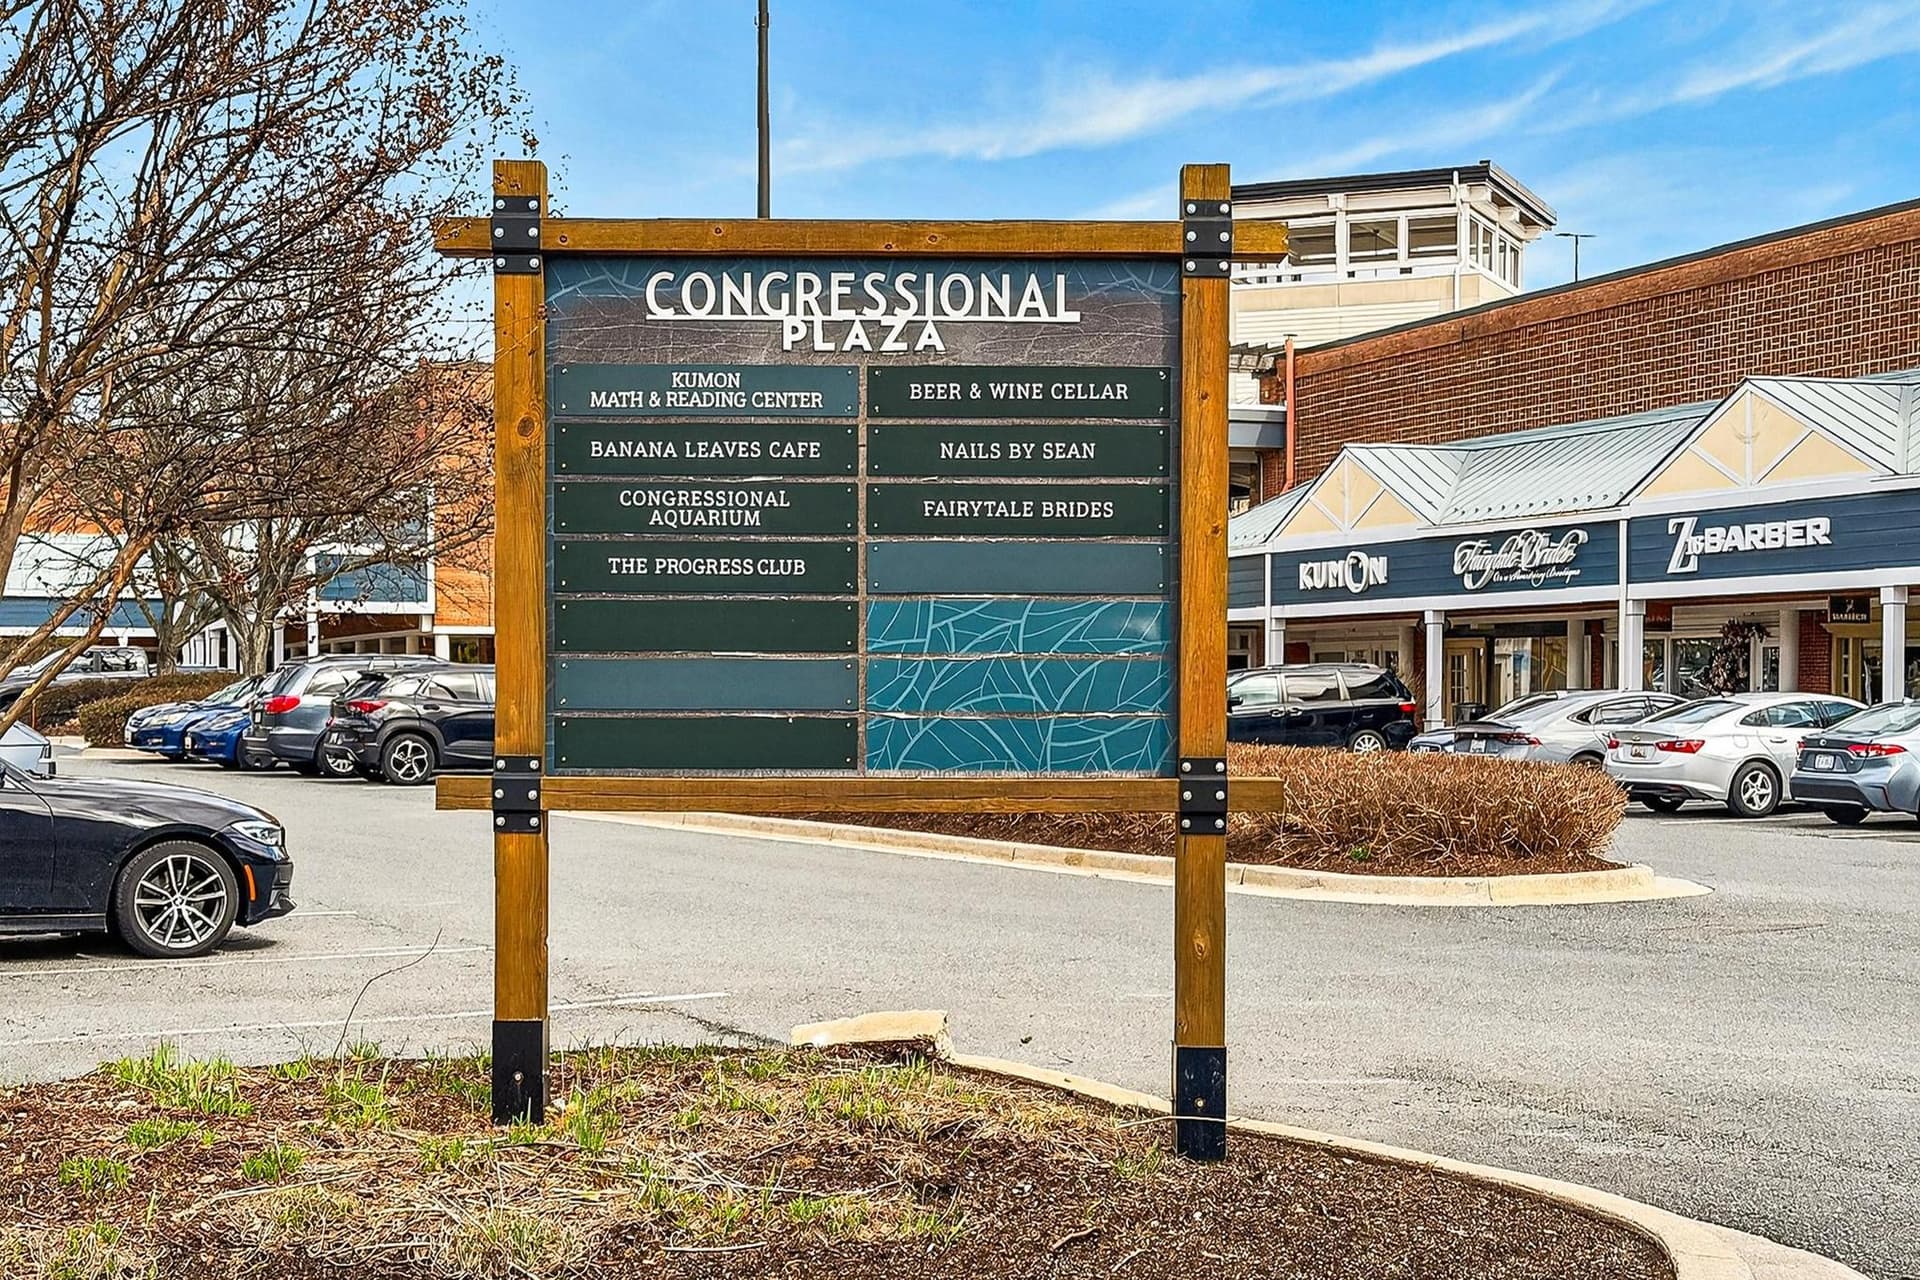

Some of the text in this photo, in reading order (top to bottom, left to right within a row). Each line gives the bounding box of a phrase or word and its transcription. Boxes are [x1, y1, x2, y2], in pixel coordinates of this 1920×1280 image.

[645, 271, 1081, 322] CONGRESSIONAL
[782, 317, 946, 353] PLAZA
[671, 372, 741, 388] KUMON
[590, 391, 823, 408] MATH & READING CENTER
[909, 383, 1128, 400] BEER & WINE CELLAR
[590, 441, 821, 459] BANANA LEAVES CAFE
[940, 442, 1096, 459] NAILS BY SEAN
[619, 490, 790, 508] CONGRESSIONAL
[649, 509, 761, 529] AQUARIUM
[923, 501, 1114, 519] FAIRYTALE BRIDES
[1704, 517, 1833, 555] BARBER
[608, 557, 806, 575] THE PROGRESS CLUB
[1299, 551, 1388, 593] KUMON
